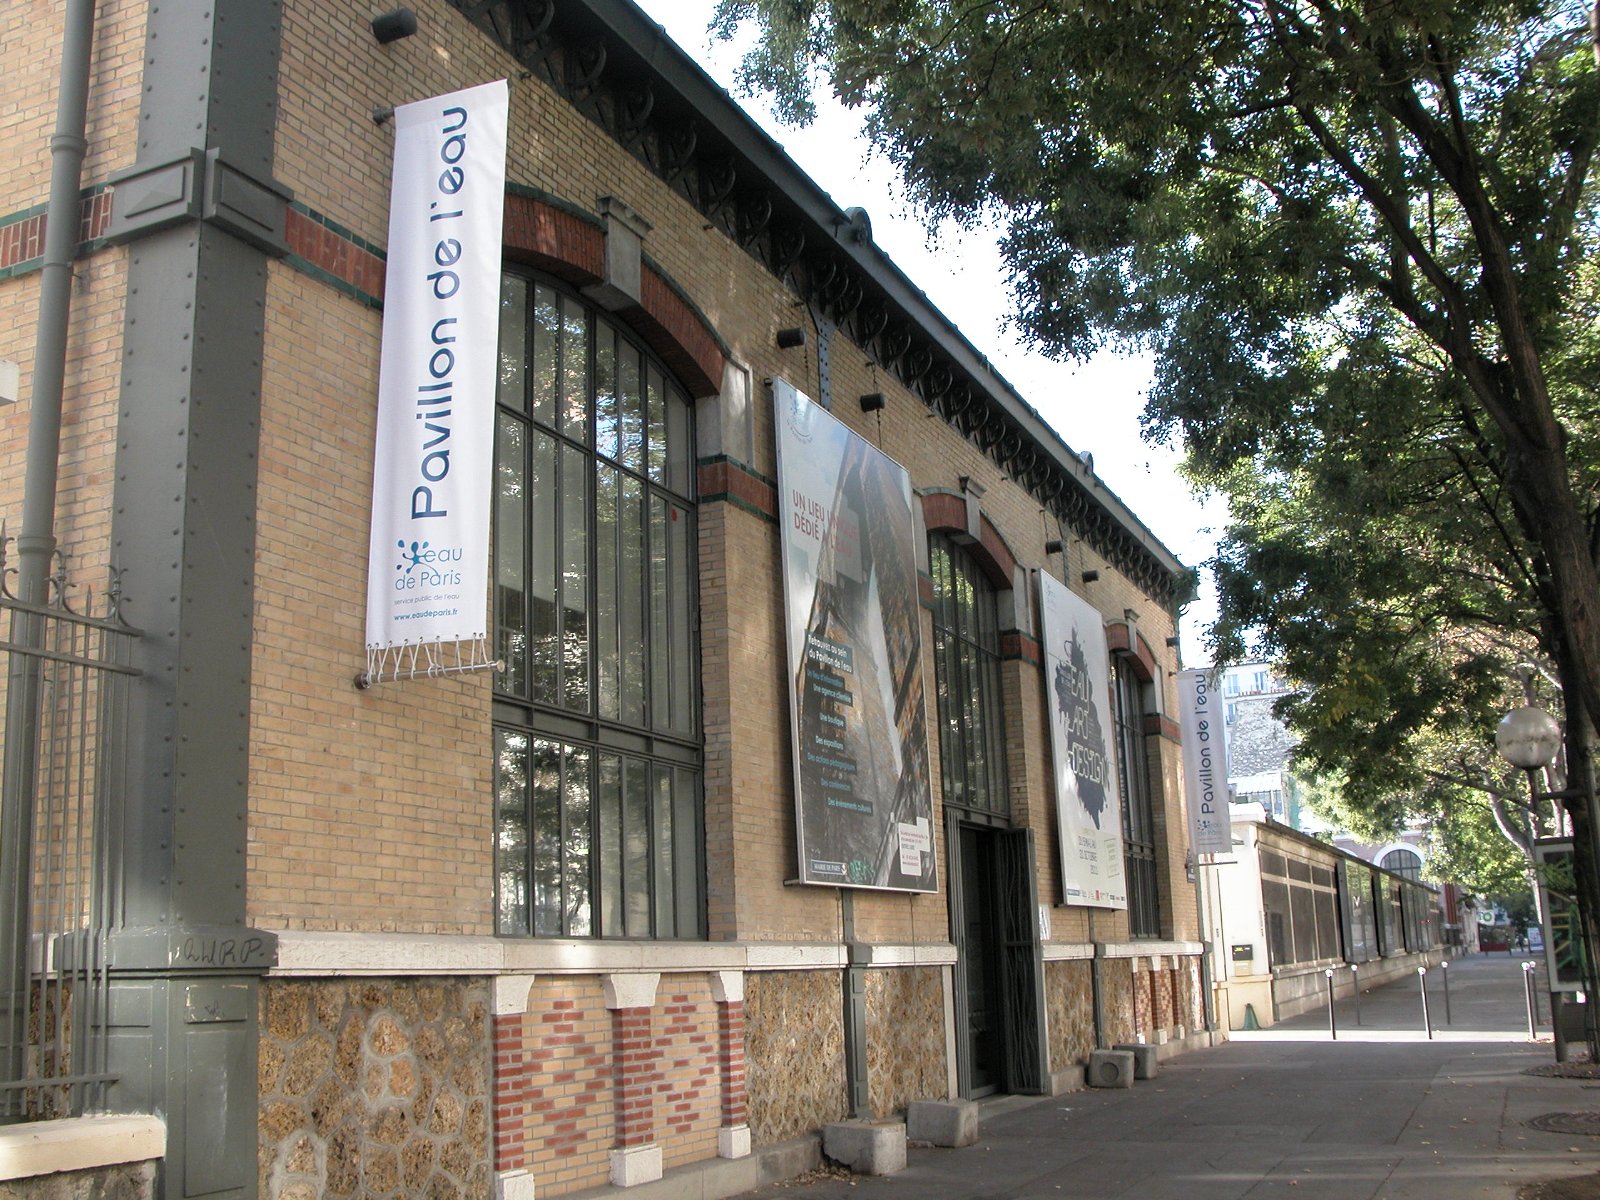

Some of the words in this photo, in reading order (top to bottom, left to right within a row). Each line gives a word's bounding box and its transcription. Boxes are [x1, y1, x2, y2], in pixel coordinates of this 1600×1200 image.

[430, 106, 468, 222] l'eau
[427, 238, 462, 300] de
[411, 317, 458, 520] Pavillon
[792, 489, 806, 511] UN
[808, 498, 825, 522] LIEU
[794, 511, 820, 541] DÉDIÉ
[424, 548, 463, 563] eau
[395, 575, 416, 591] de
[420, 569, 462, 588] Paris
[394, 607, 458, 621] www.eaudeparis.fr
[815, 650, 834, 666] Pavillon
[1194, 674, 1208, 714] l'eau
[1196, 720, 1210, 742] de
[1070, 742, 1107, 784] DESIGN
[1199, 747, 1215, 814] Pavillon
